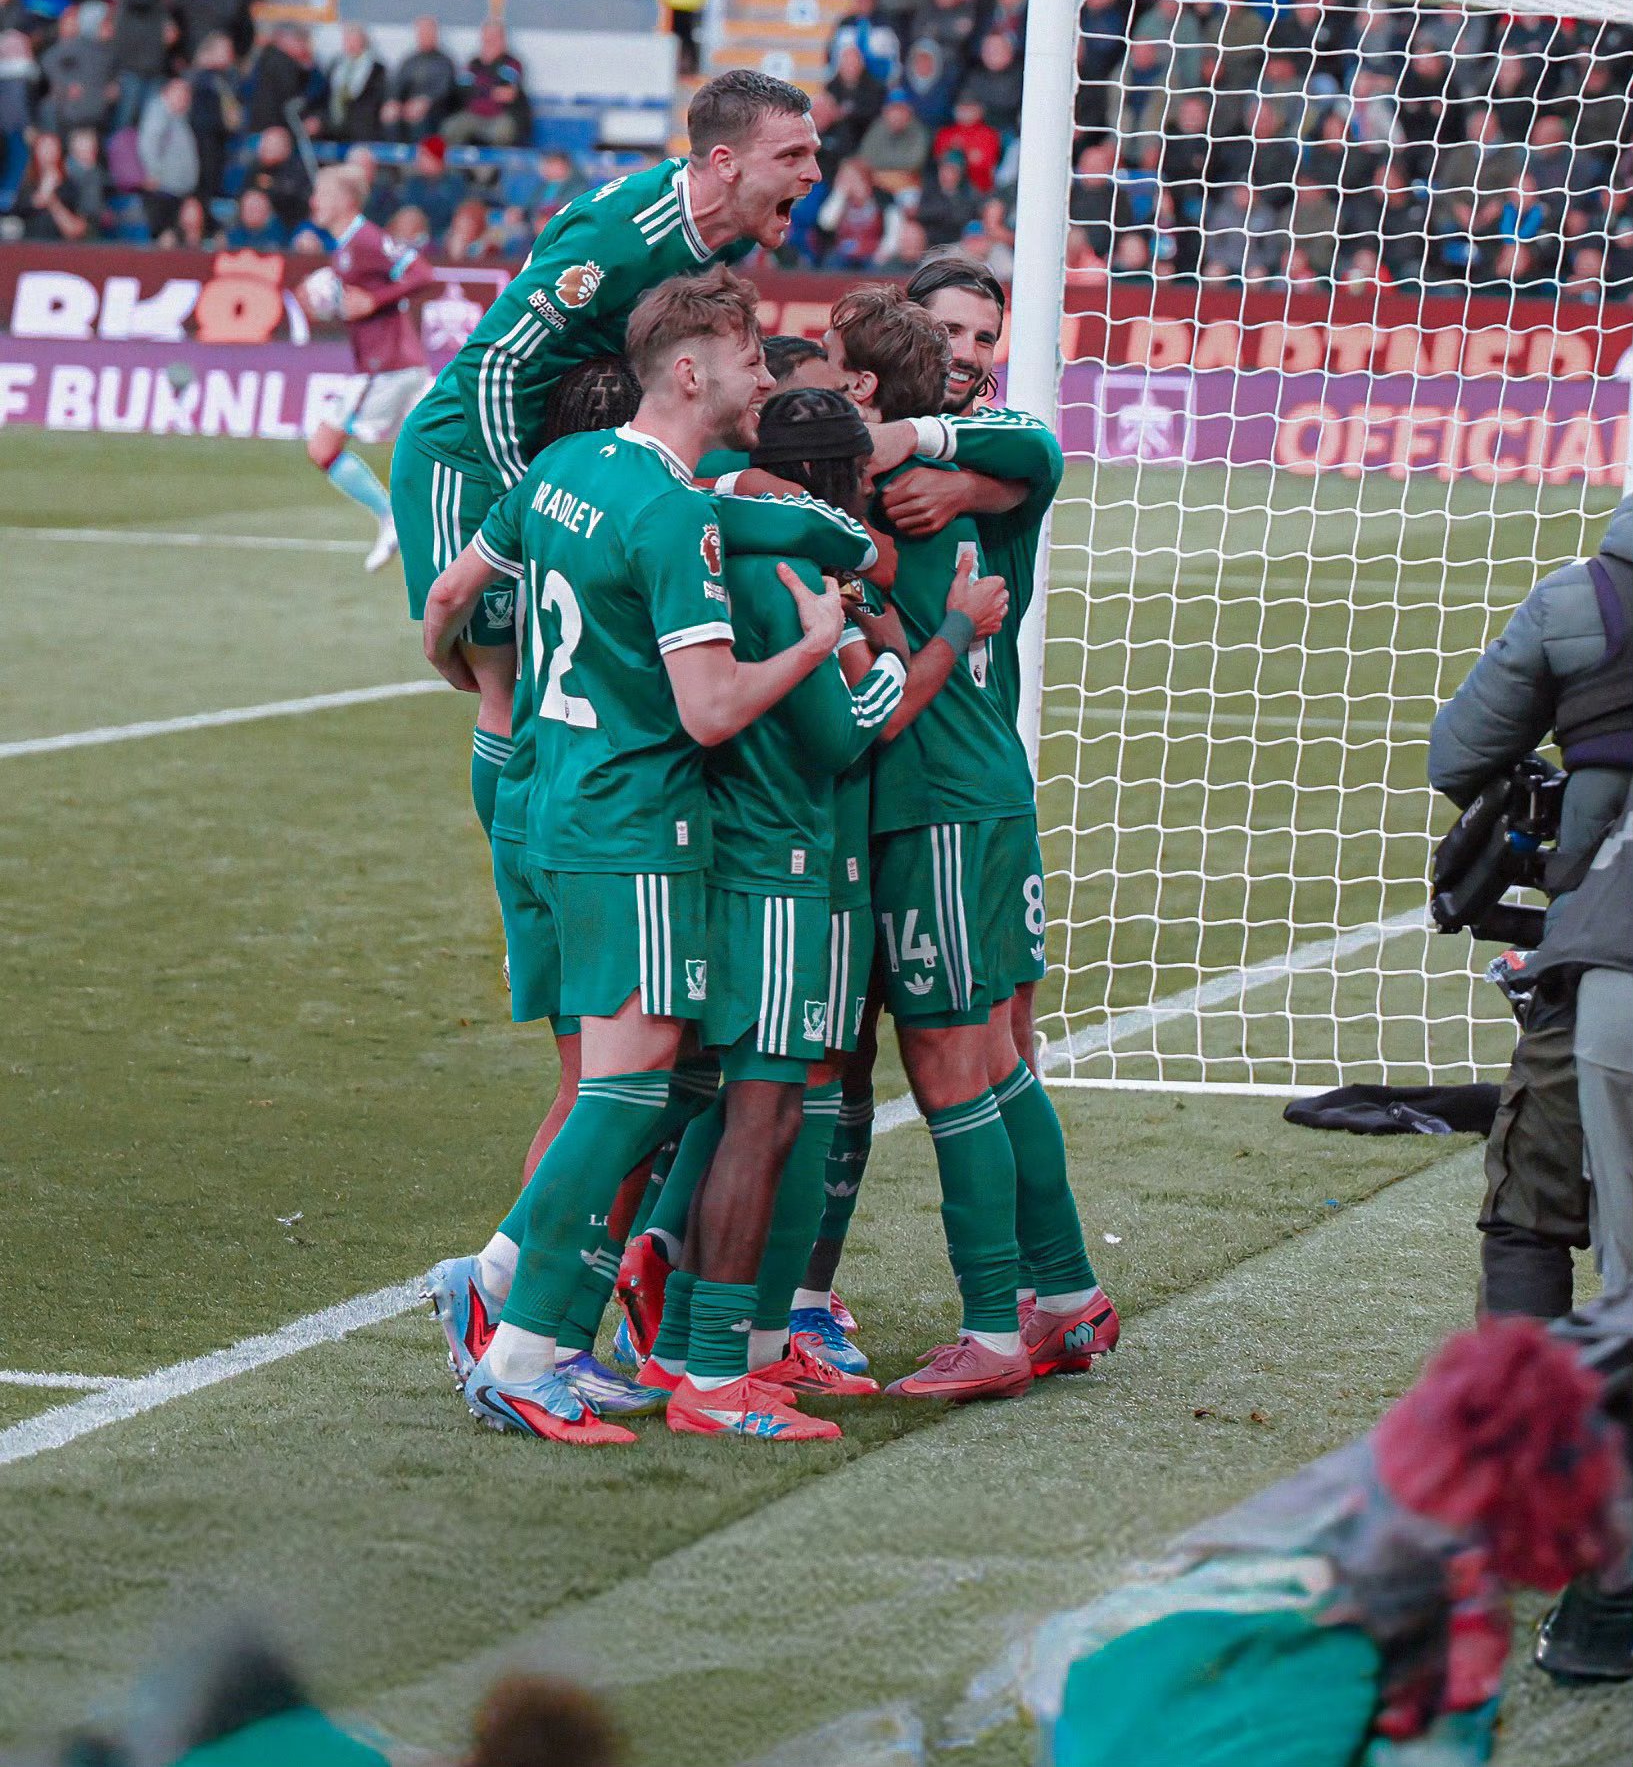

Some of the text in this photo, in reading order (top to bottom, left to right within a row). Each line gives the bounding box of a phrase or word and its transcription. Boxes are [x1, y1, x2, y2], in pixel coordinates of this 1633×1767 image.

[46, 365, 400, 440] BURNLE
[1023, 874, 1046, 935] 8
[882, 909, 938, 973] 14
